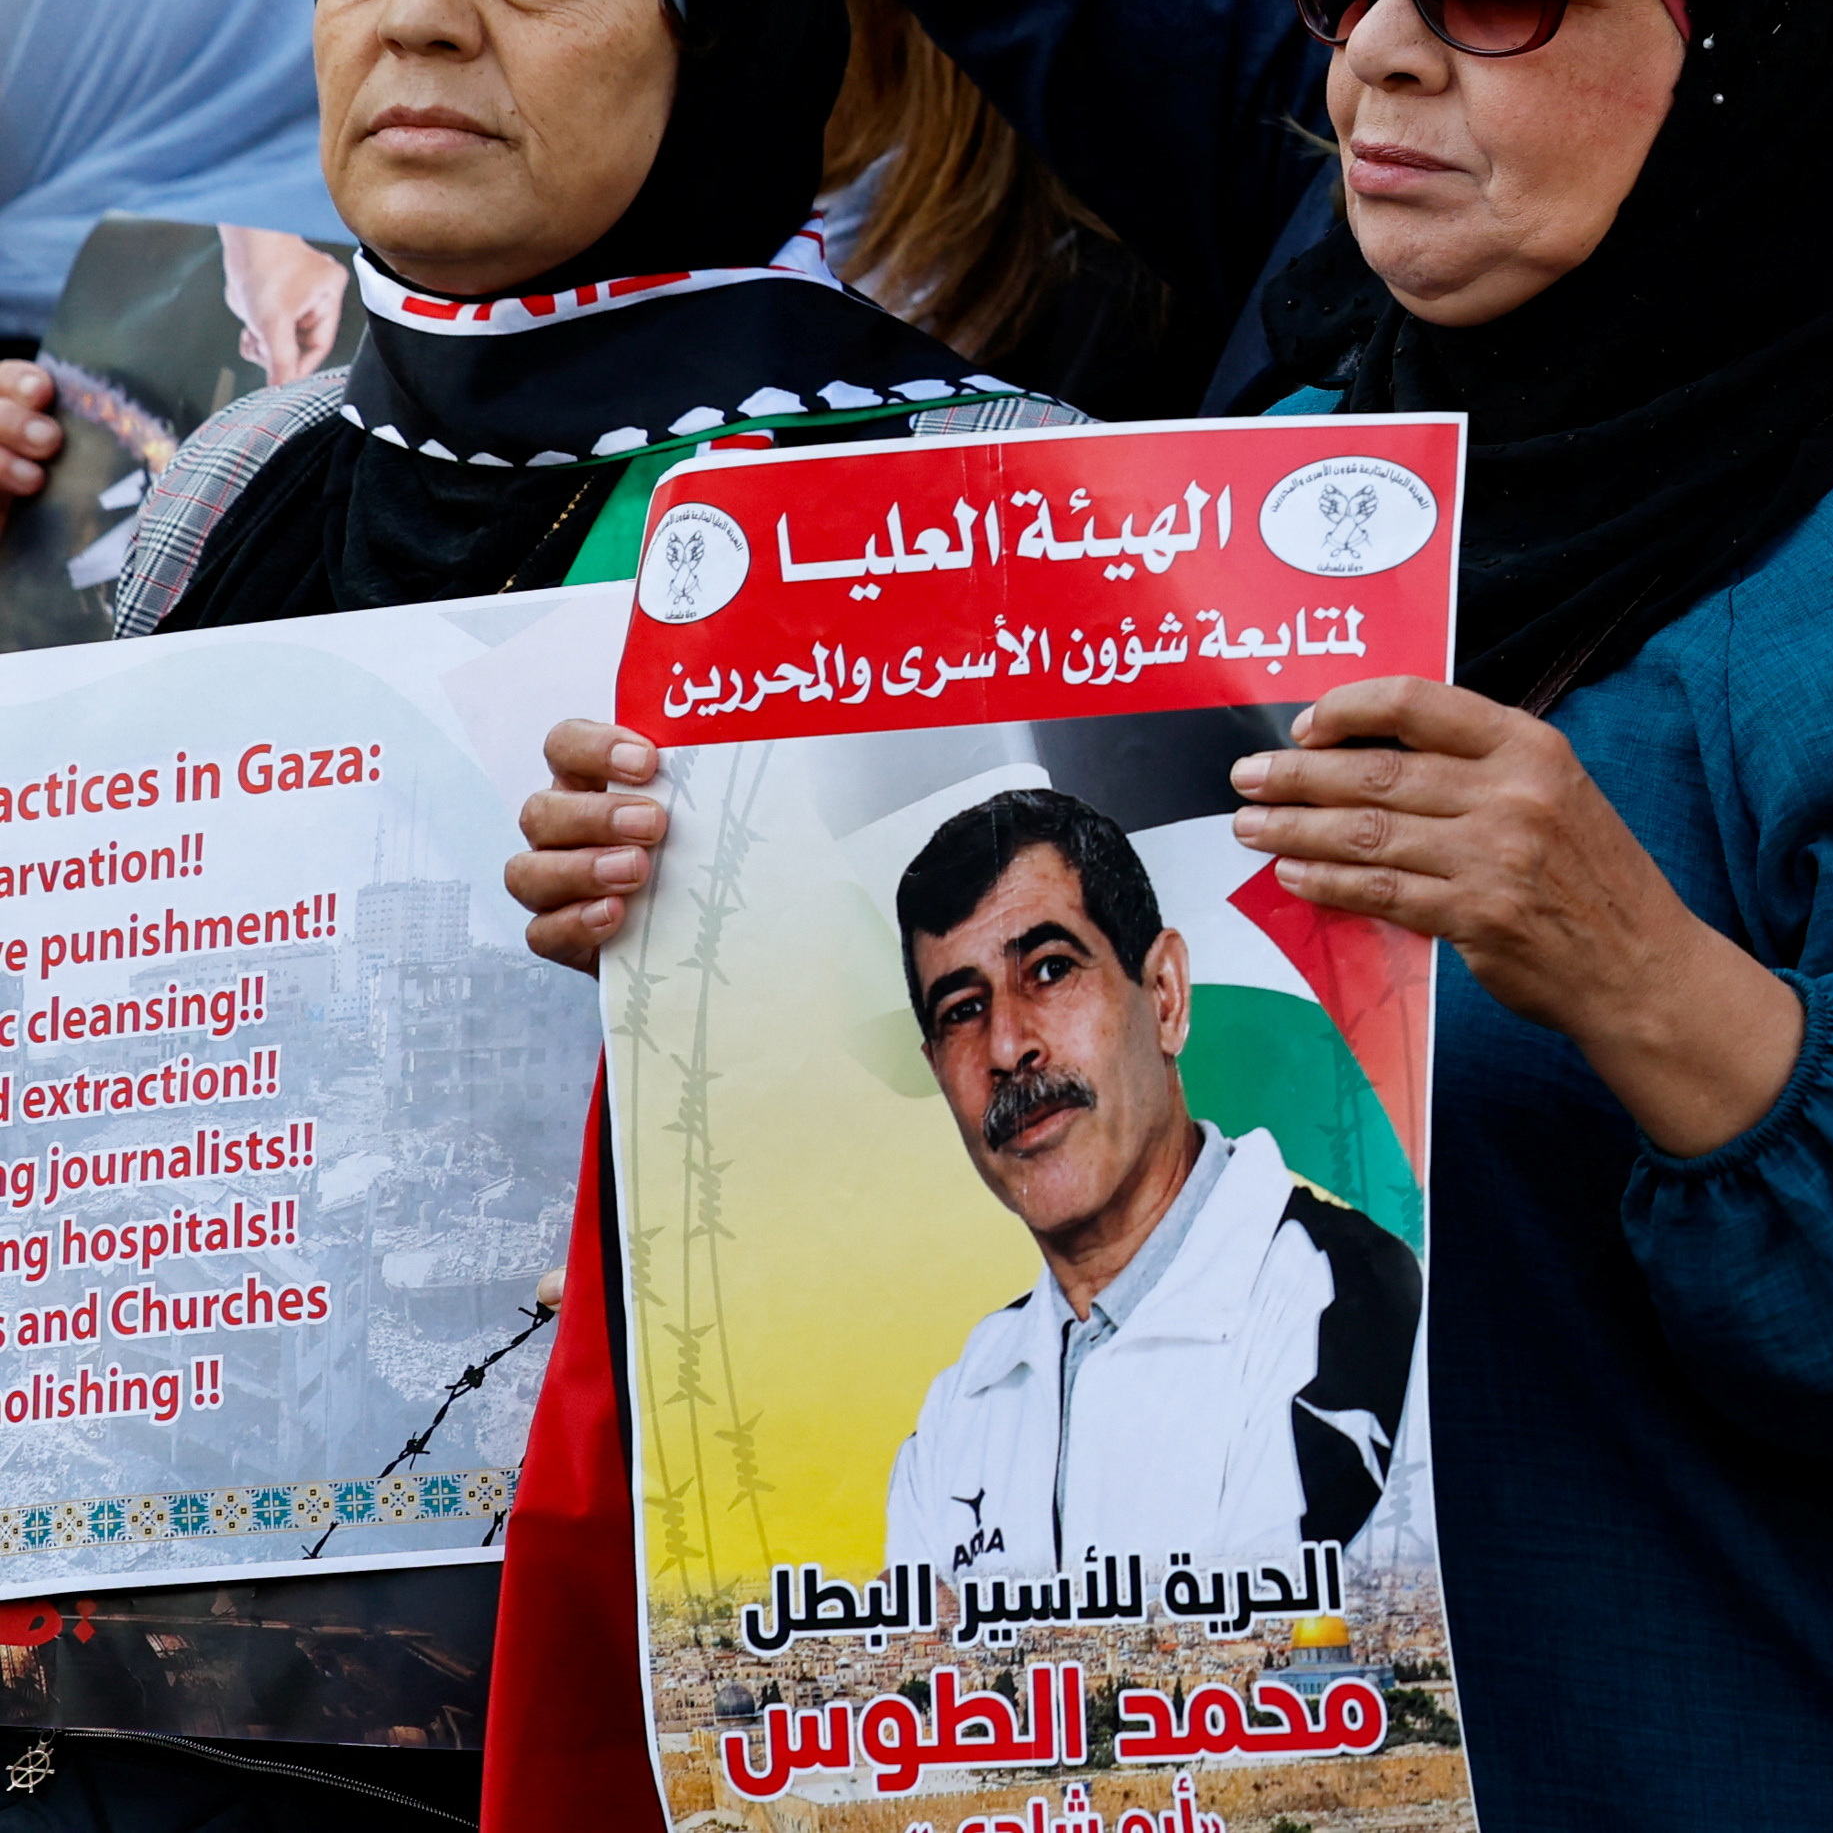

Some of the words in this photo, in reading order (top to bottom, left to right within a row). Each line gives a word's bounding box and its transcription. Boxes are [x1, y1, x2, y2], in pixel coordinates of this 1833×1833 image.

[776, 497, 1001, 602] العليا
[1013, 481, 1232, 582] الهيئة
[882, 614, 1052, 699] الأسرى
[1062, 610, 1188, 686] شؤون
[1197, 603, 1366, 676] لمتابعة
[664, 641, 874, 720] والمحررين
[175, 752, 221, 802] in
[238, 743, 382, 794] Gaza:
[0, 938, 27, 973] e
[41, 893, 337, 979] punishment!!
[27, 976, 265, 1043] cleansing!!
[23, 1050, 278, 1119] extraction!!
[0, 1165, 33, 1208] g
[46, 1122, 315, 1204] journalists!!
[63, 1200, 296, 1270] hospitals!!
[18, 1292, 98, 1346] and
[112, 1277, 329, 1335] Churches
[195, 1360, 219, 1406] !!
[746, 1565, 931, 1654] البطل
[958, 1547, 1143, 1645] للأسير
[1168, 1545, 1341, 1637] الحرية
[725, 1665, 1084, 1797] الطوس
[1121, 1680, 1386, 1755] محمد
